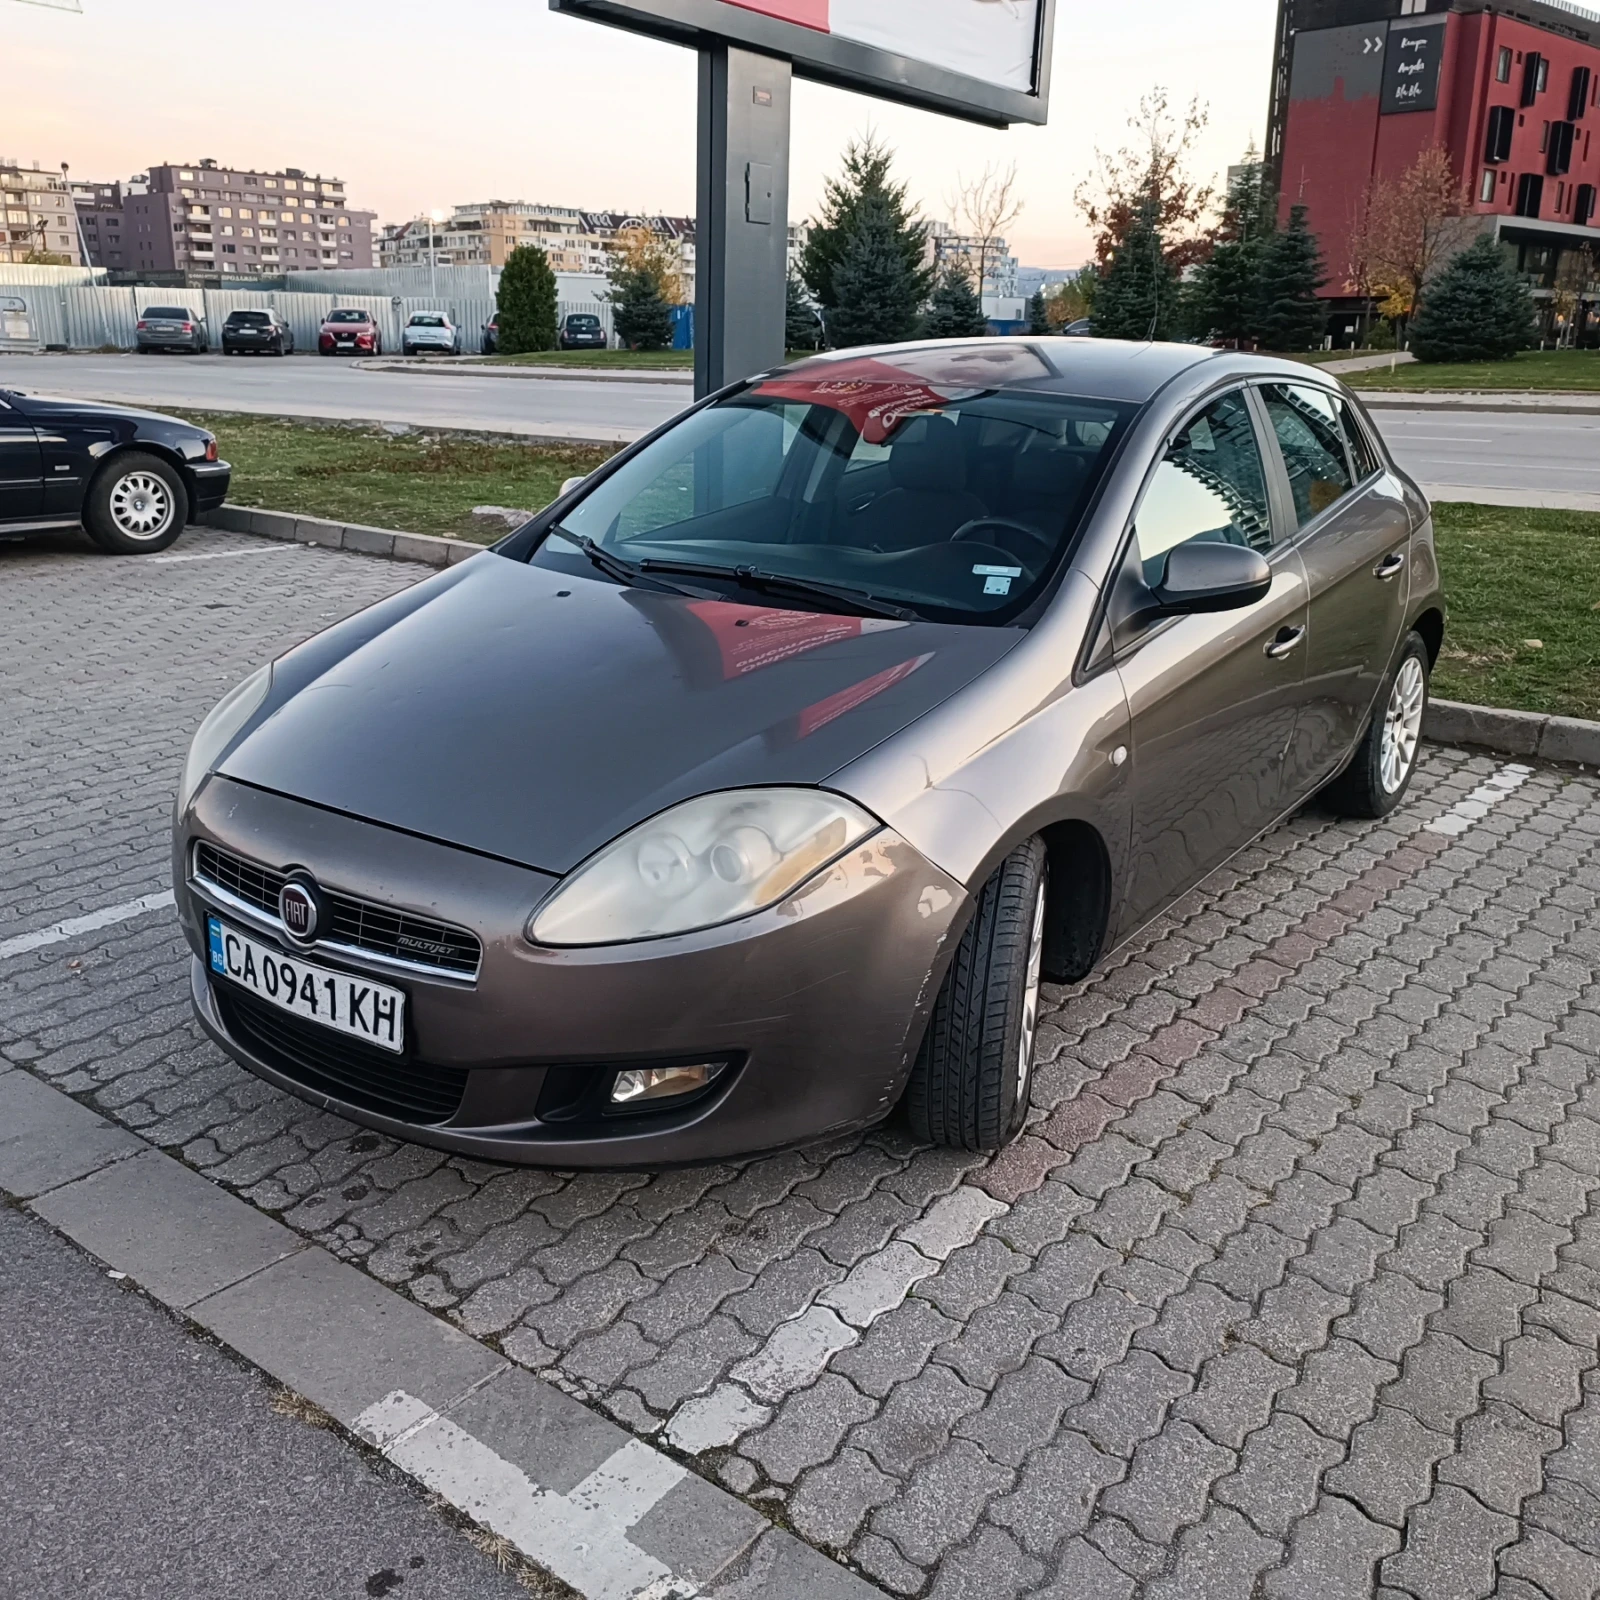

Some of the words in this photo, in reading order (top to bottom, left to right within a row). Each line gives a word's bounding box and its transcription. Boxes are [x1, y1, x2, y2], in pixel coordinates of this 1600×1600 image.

[286, 899, 307, 926] FIAT
[397, 936, 456, 956] MULTIJET
[212, 950, 224, 967] BG
[225, 933, 259, 988] CA
[263, 954, 337, 1022] 0941
[349, 982, 396, 1043] KH
